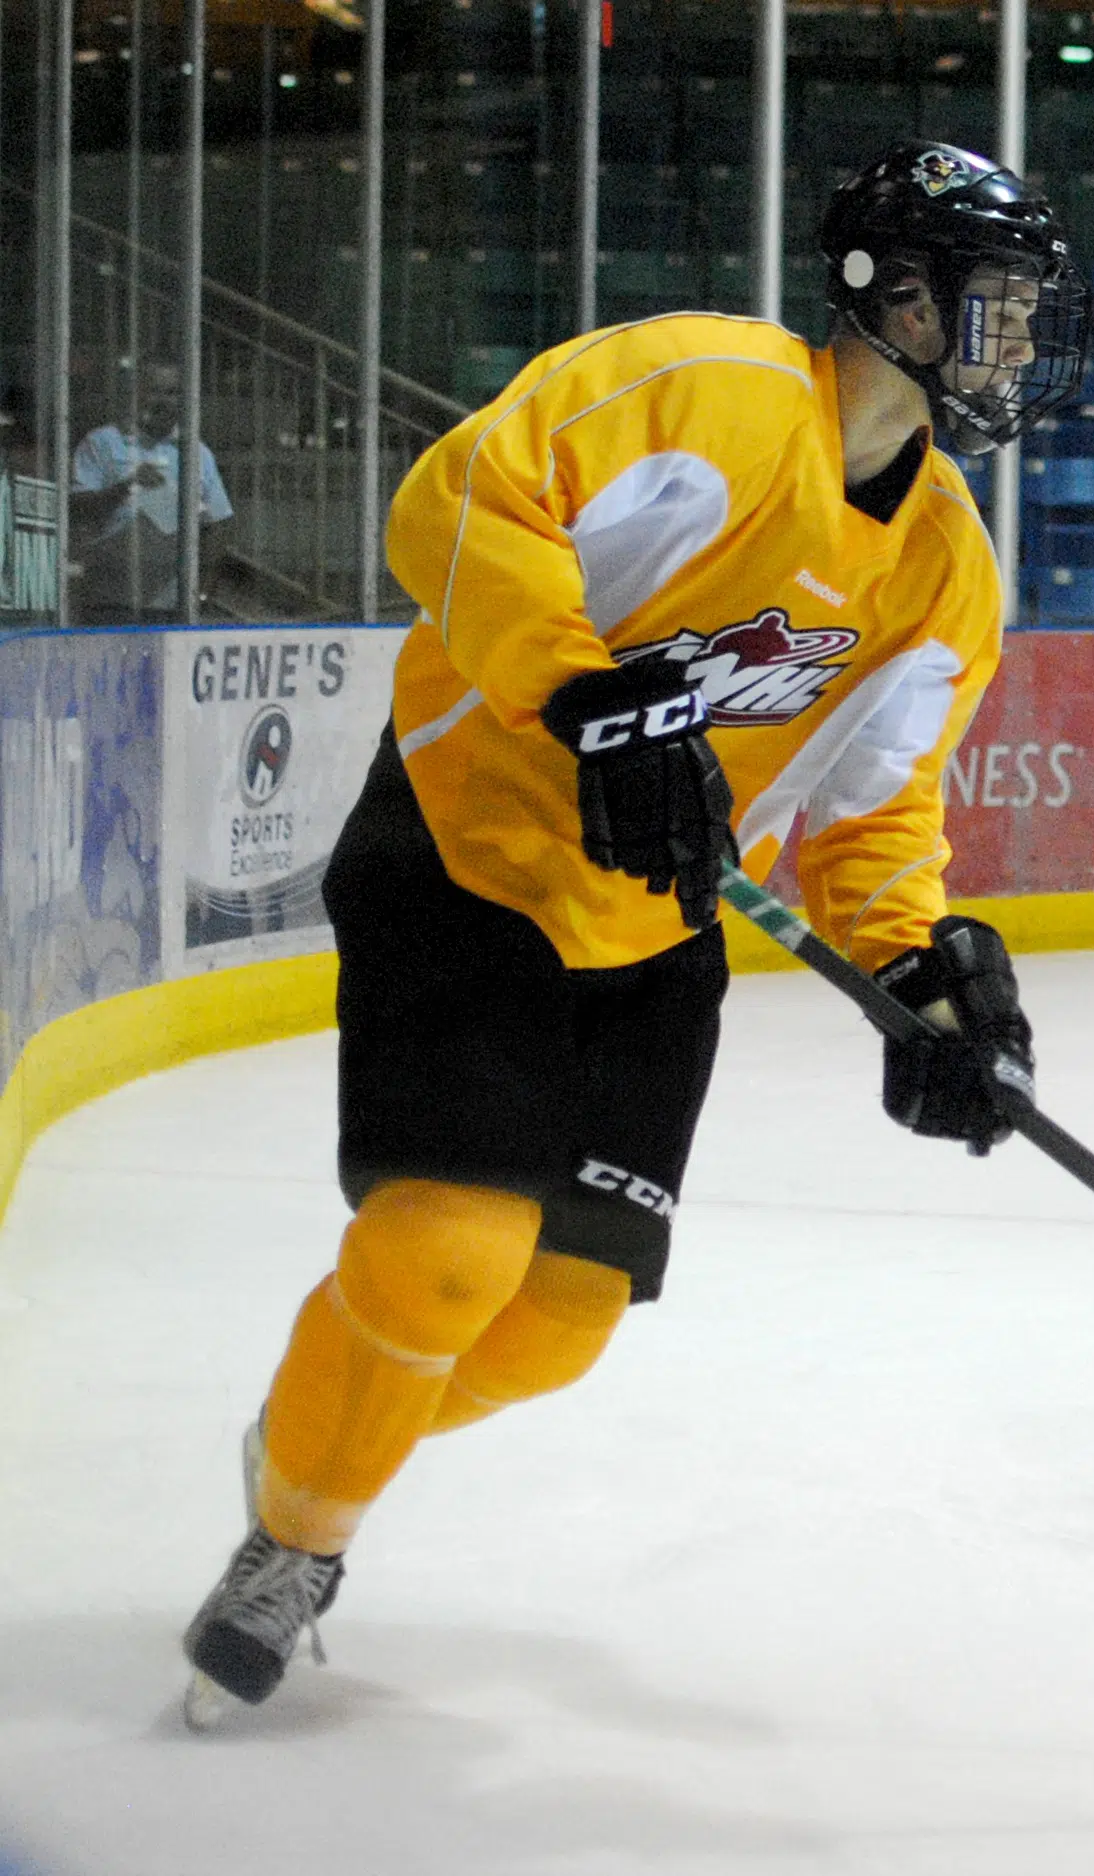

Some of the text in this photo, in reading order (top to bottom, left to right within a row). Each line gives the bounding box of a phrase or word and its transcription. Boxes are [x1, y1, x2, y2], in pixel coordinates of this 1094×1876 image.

[794, 568, 847, 608] Reebok
[193, 641, 345, 703] GENE'S
[685, 651, 846, 713] WHL
[231, 812, 293, 846] SPORTS
